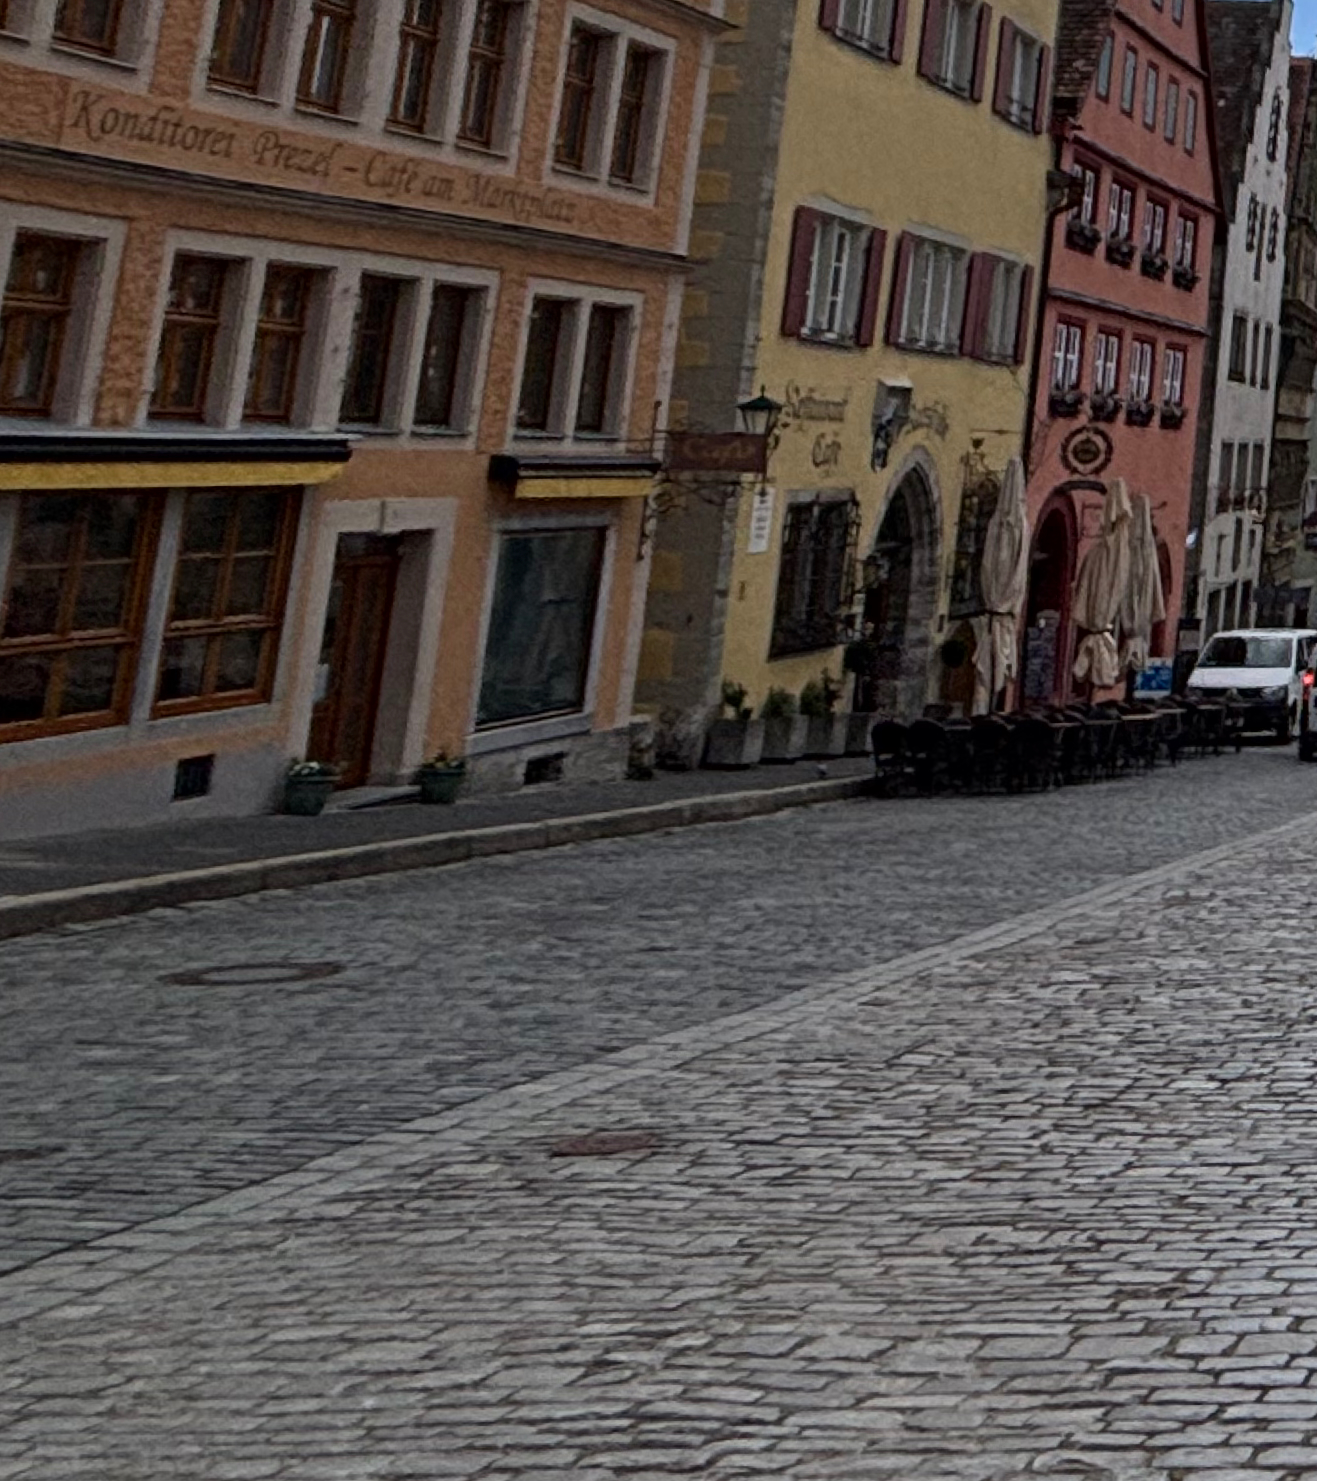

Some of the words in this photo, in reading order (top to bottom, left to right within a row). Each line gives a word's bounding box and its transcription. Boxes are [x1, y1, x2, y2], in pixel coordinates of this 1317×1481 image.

[71, 90, 238, 158] Konditorei
[254, 130, 344, 177] Prezel
[422, 175, 455, 201] am
